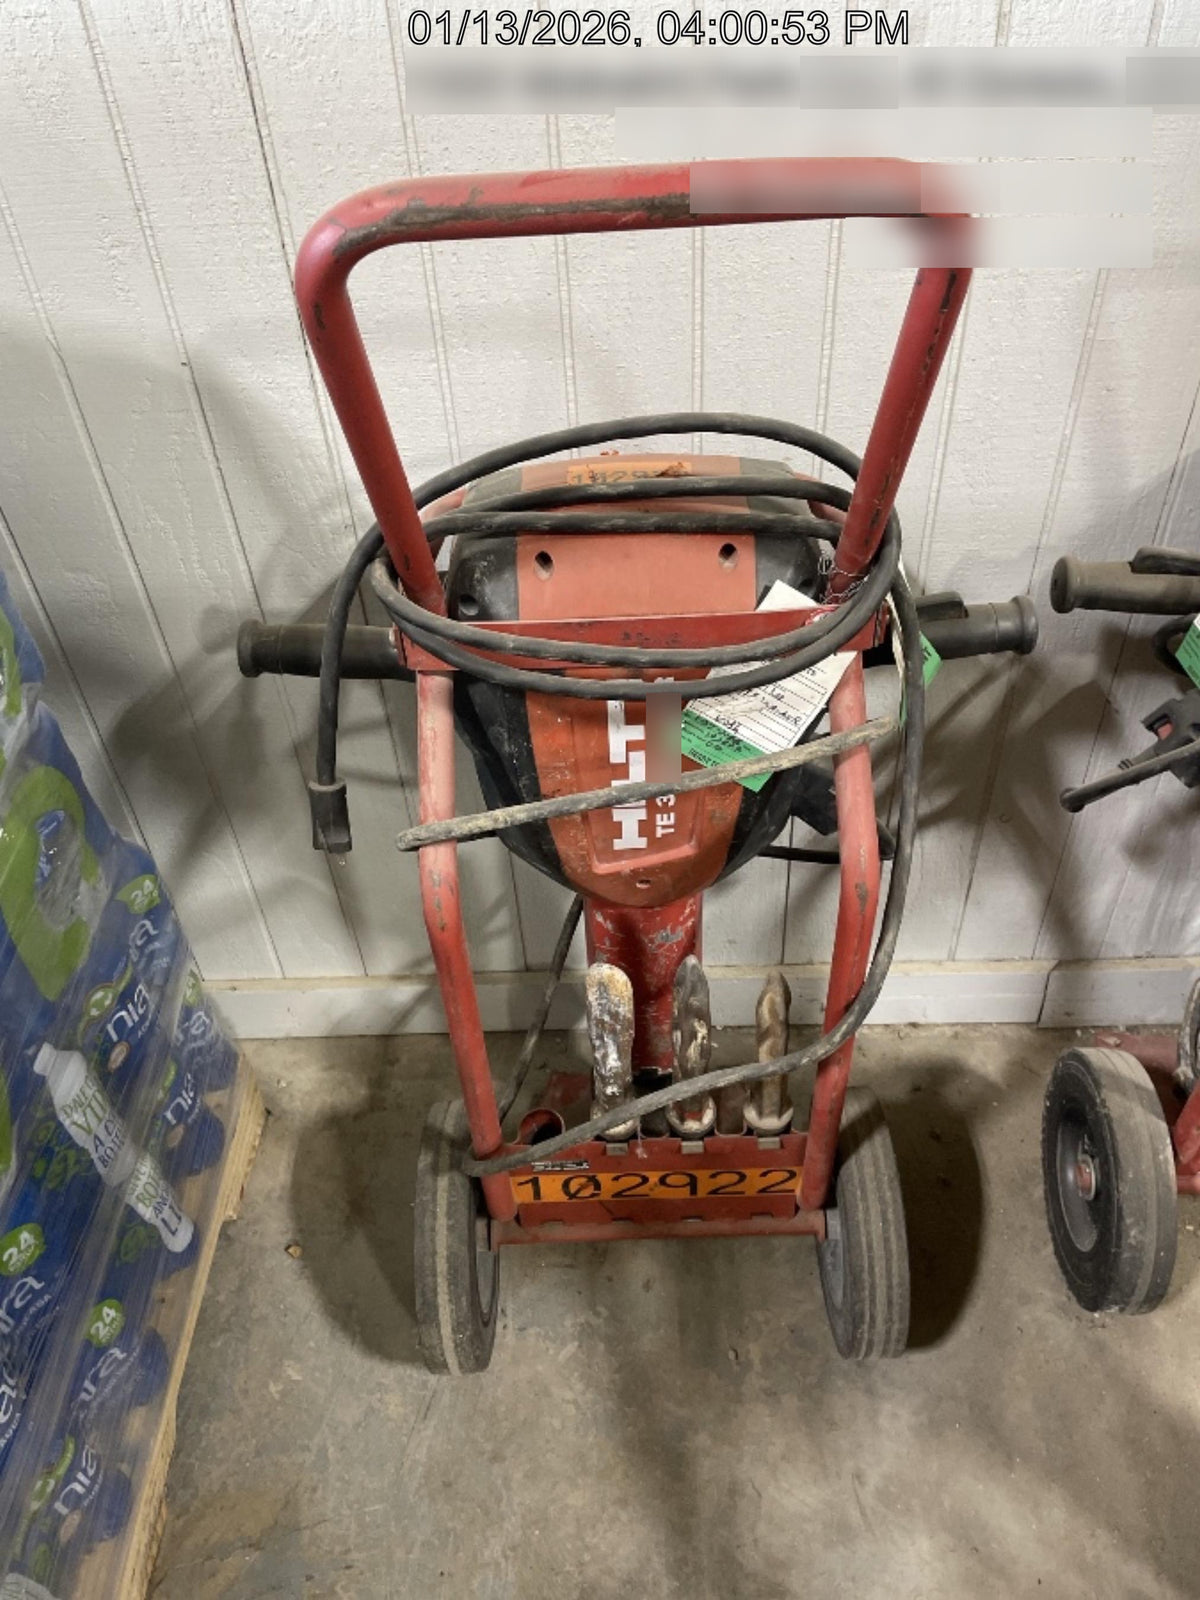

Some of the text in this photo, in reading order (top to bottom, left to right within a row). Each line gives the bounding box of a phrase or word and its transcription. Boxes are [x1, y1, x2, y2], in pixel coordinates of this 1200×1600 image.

[606, 679, 648, 850] HLT
[655, 813, 675, 838] TE
[90, 1305, 116, 1340] 24
